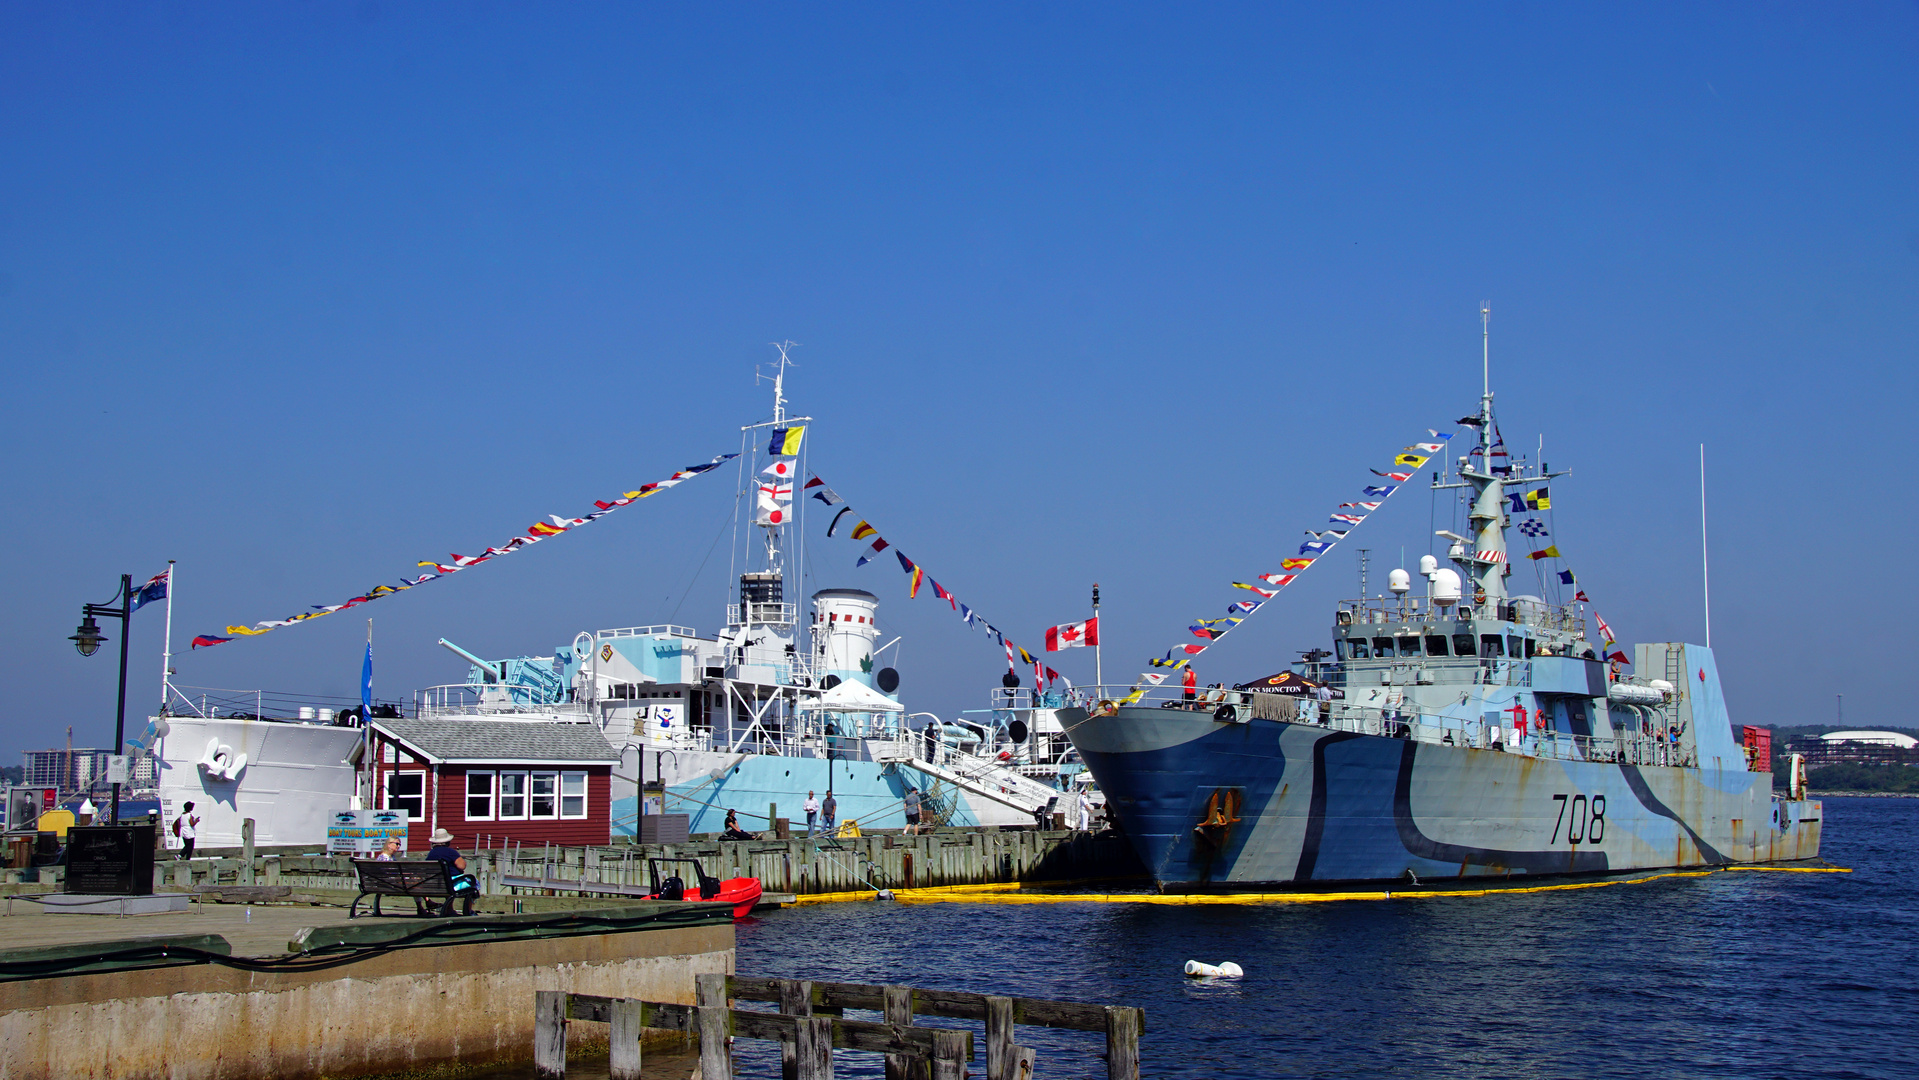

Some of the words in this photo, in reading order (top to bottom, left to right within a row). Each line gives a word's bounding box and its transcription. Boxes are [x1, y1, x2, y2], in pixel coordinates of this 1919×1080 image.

[1550, 794, 1606, 844] 708
[329, 828, 342, 837] BOAT
[344, 829, 362, 837] TOURS
[364, 828, 383, 837] BOAT
[384, 828, 406, 837] TOURS
